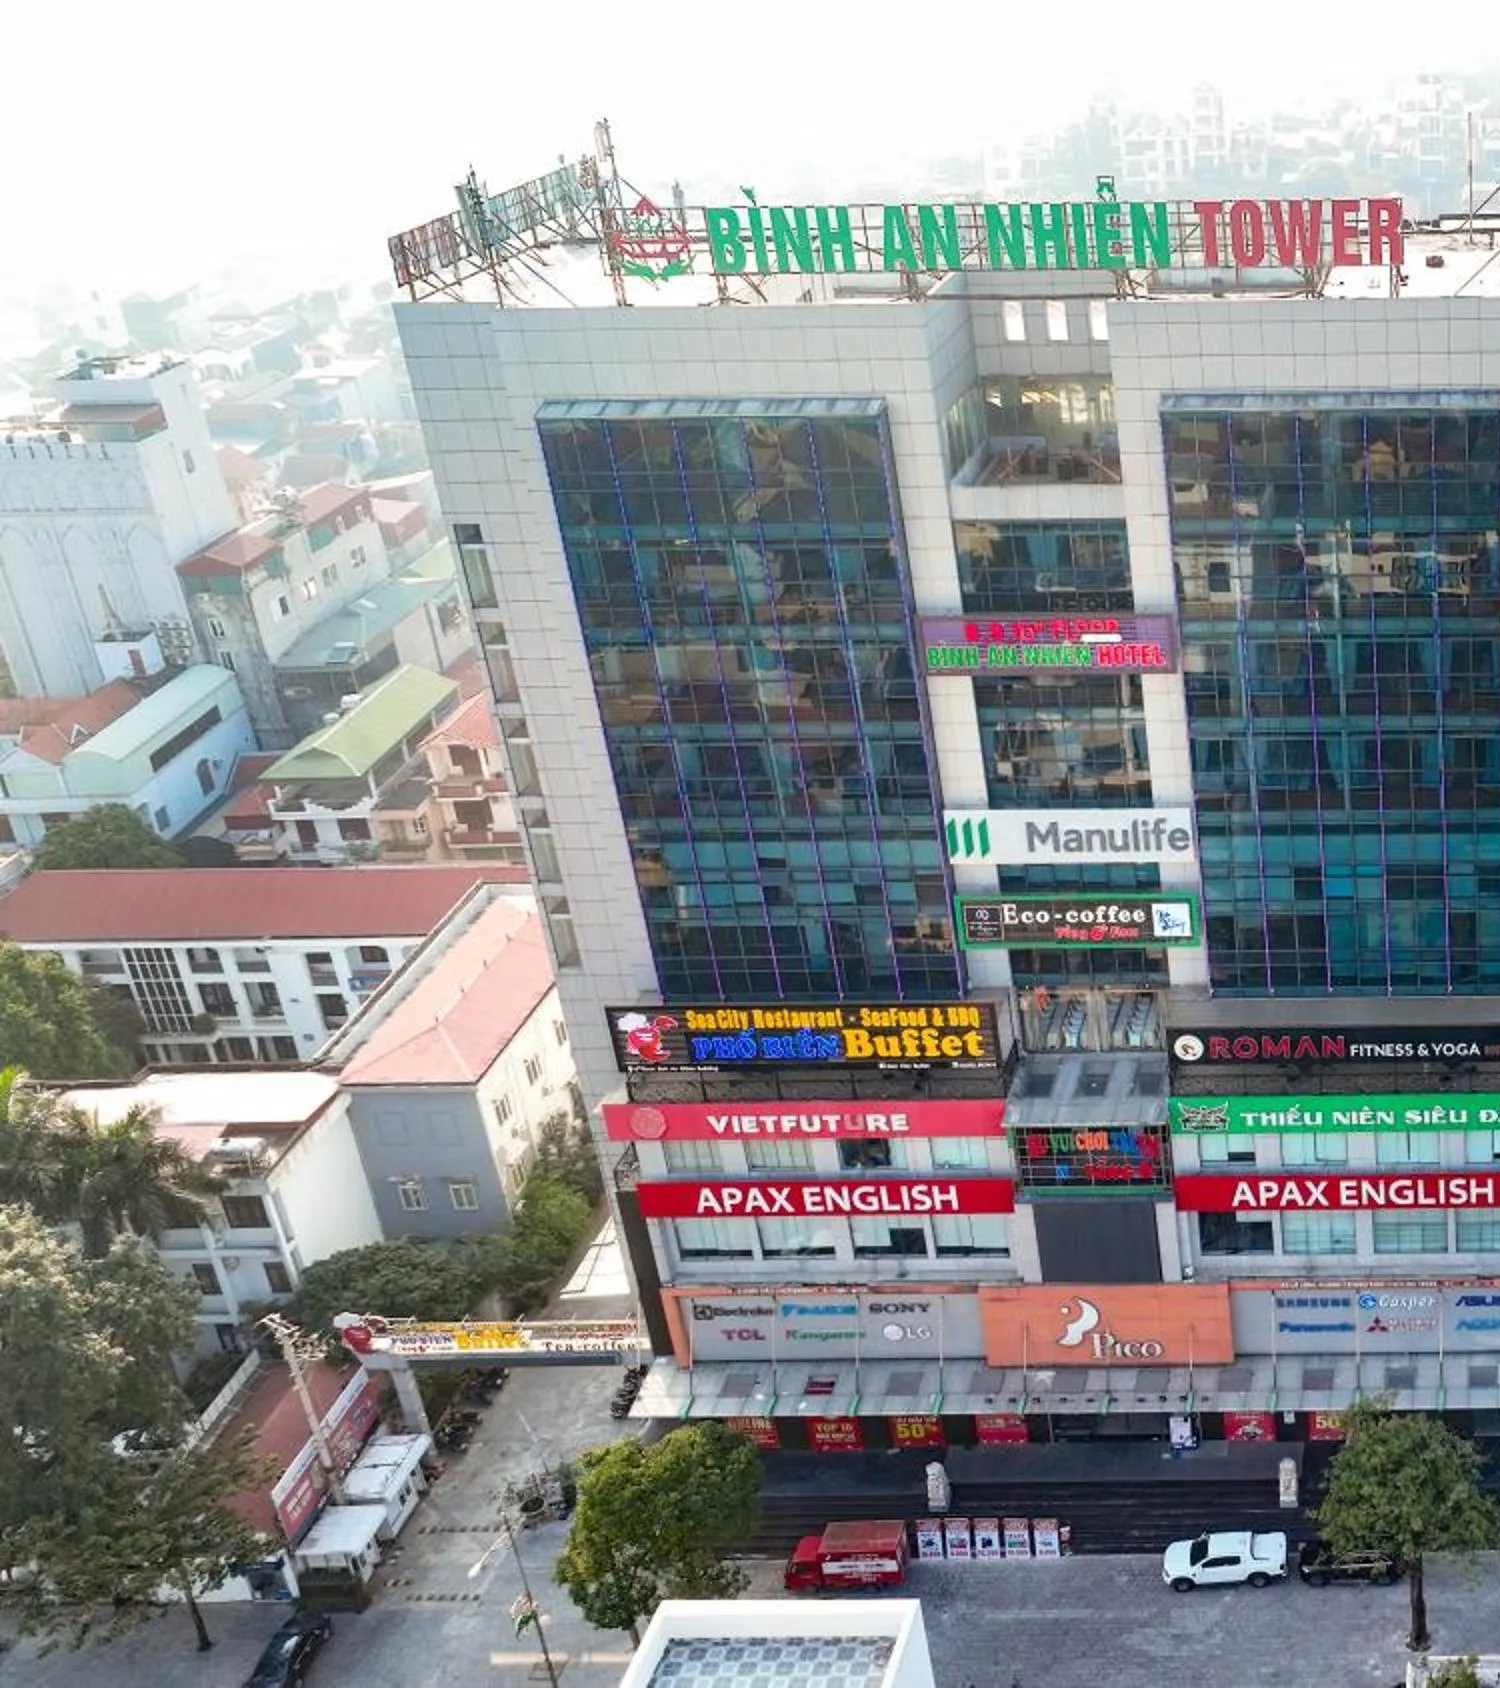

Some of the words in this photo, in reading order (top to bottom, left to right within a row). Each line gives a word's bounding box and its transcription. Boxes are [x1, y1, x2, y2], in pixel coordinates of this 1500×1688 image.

[707, 186, 855, 274] BÌNH
[882, 203, 962, 272] AN
[984, 177, 1171, 270] NHIÊN
[1194, 198, 1403, 267] TOWER
[1097, 643, 1167, 666] HOTEL
[1025, 818, 1191, 852] Manulife
[1002, 903, 1146, 925] Eco-coffee
[752, 1008, 844, 1029] Restaurant
[859, 1007, 928, 1028] SeaFood
[931, 1008, 945, 1028] &
[947, 1007, 981, 1029] BBQ
[841, 1028, 984, 1058] Buffet
[1208, 1034, 1346, 1060] ROMAN
[1350, 1043, 1414, 1058] FITNESS
[1416, 1043, 1431, 1058] &
[1432, 1042, 1481, 1056] YOGA
[706, 1113, 910, 1135] VIETFUTURE
[1240, 1103, 1324, 1127] THIẾU
[1332, 1105, 1395, 1126] NIÊN
[1403, 1105, 1468, 1125] SIÊU
[697, 1187, 797, 1215] APAX
[802, 1184, 960, 1213] ENGLISH
[1232, 1181, 1328, 1208] APAX
[1340, 1179, 1496, 1206] ENGLISH
[868, 1303, 930, 1314] SONY
[1276, 1297, 1351, 1308] SAMSUNG
[1378, 1294, 1437, 1311] Casper
[721, 1329, 766, 1341] TCL
[905, 1327, 931, 1339] LG
